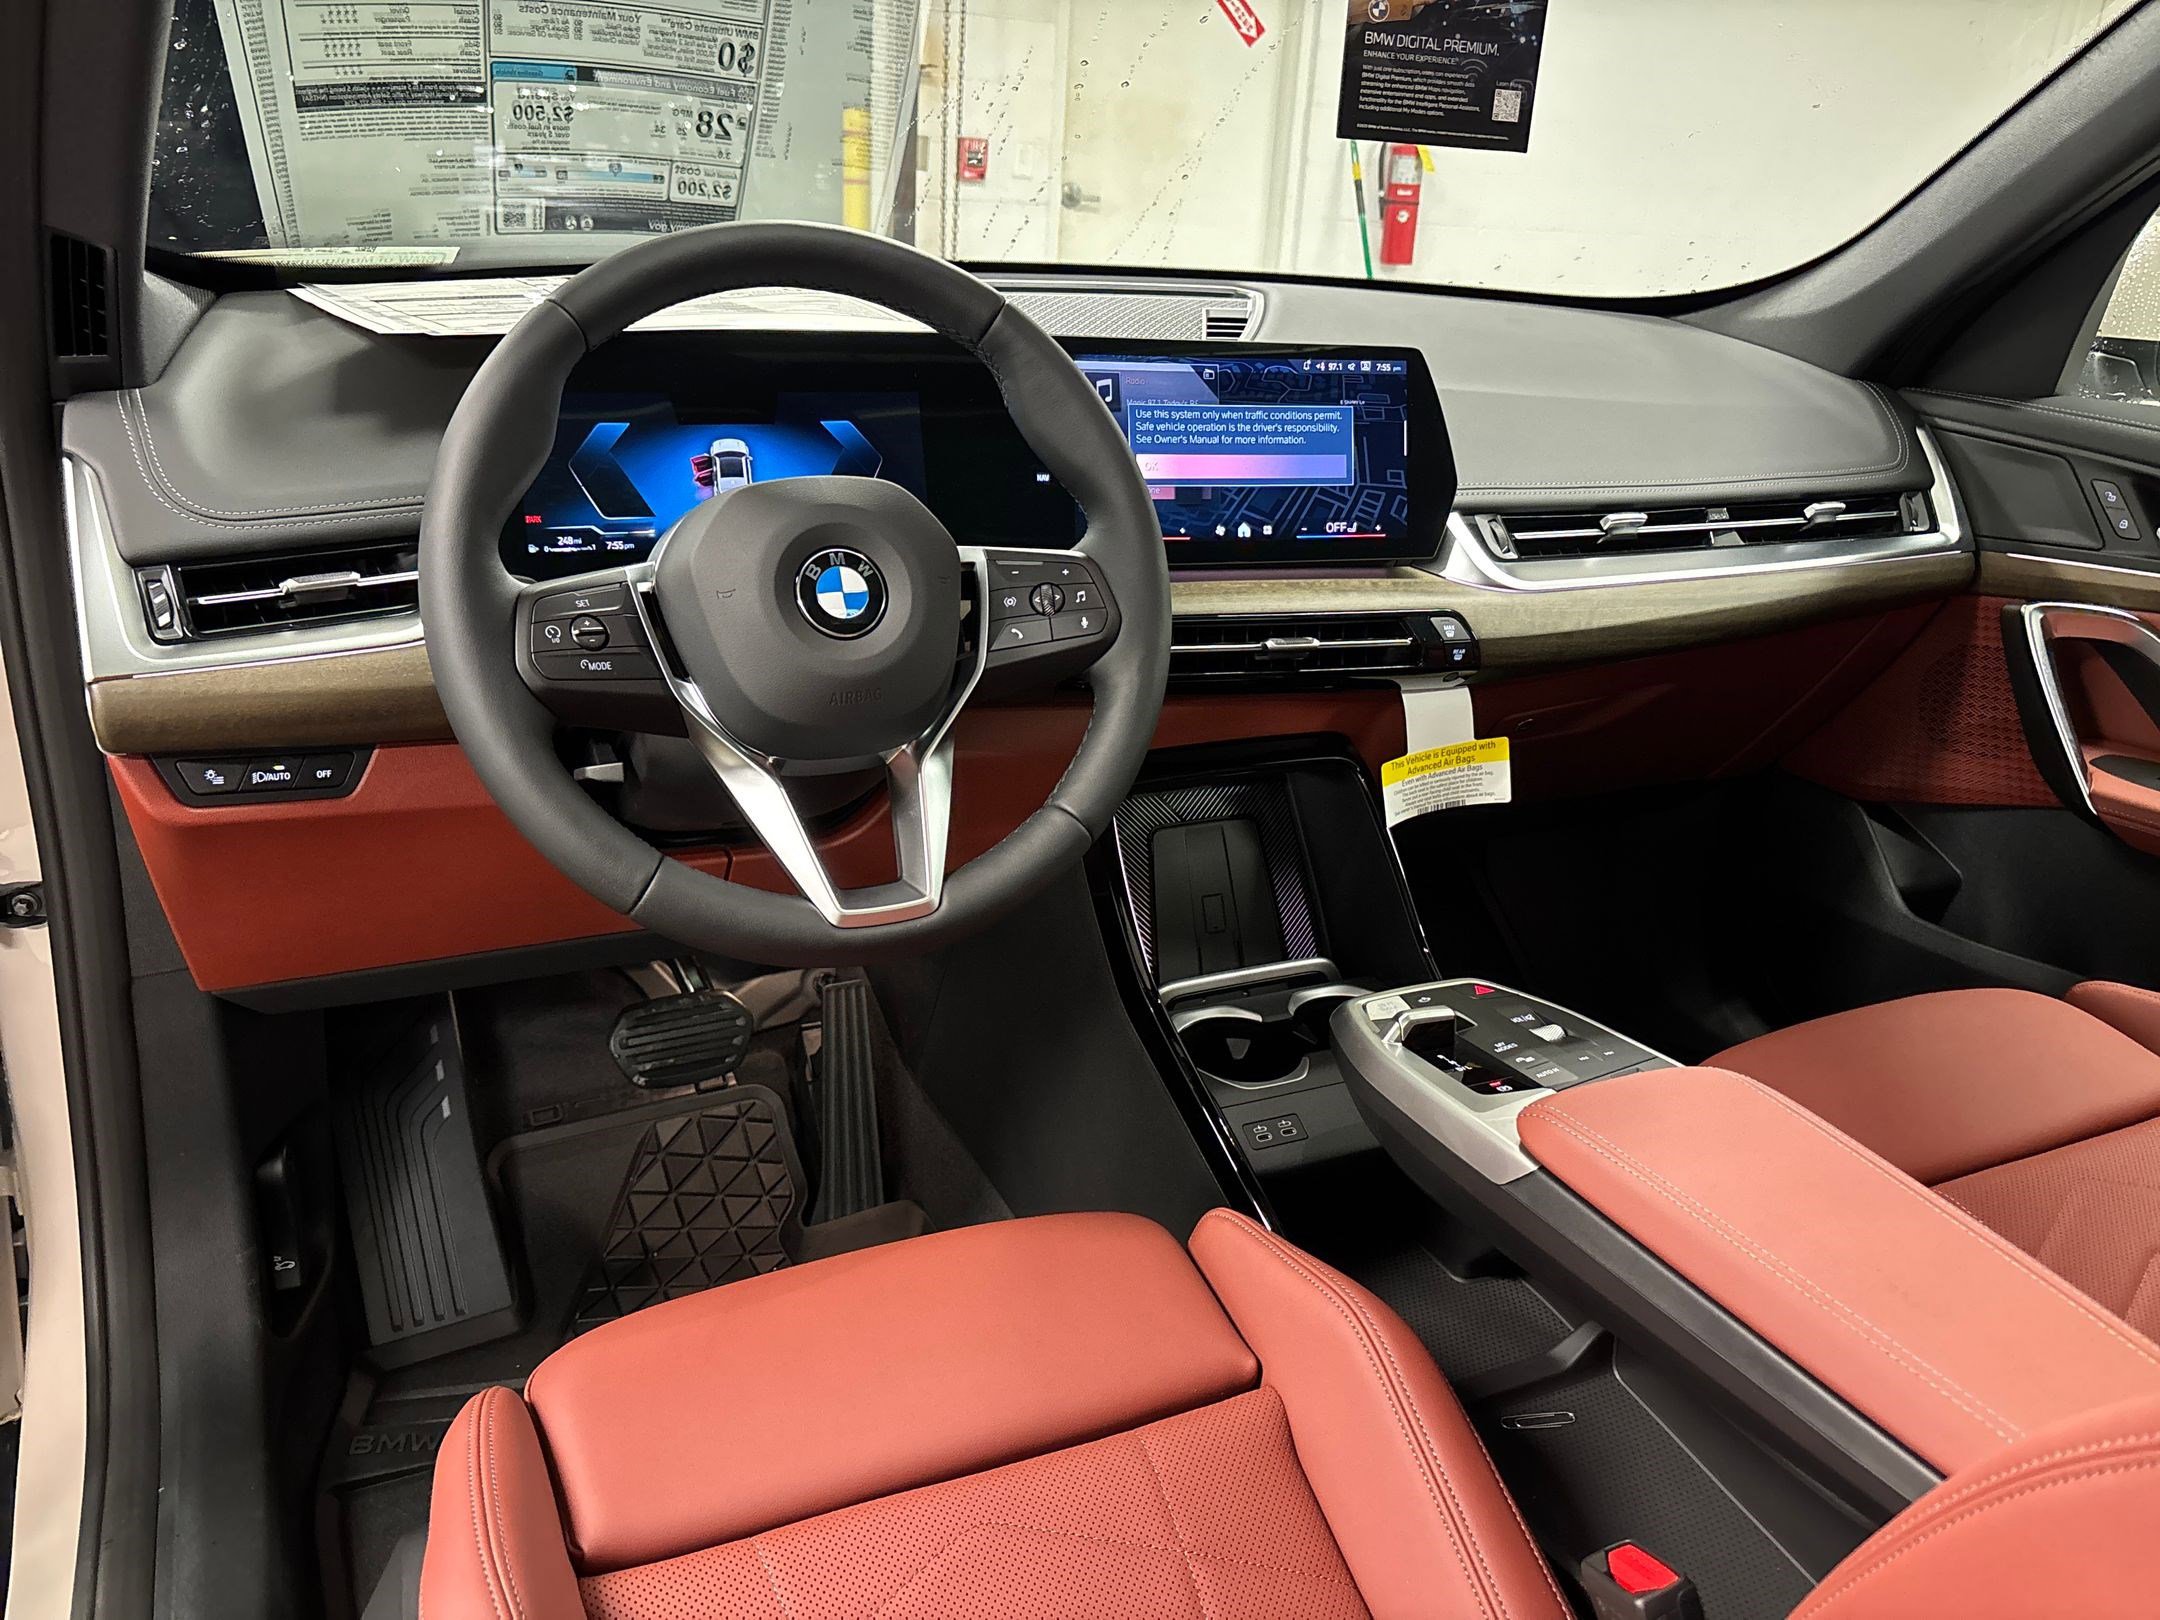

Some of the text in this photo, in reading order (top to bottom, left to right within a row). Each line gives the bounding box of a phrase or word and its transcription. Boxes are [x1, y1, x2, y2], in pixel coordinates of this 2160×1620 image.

[1364, 31, 1500, 57] BMW DIGITAL PREMIUM.
[1363, 50, 1395, 59] ENHANCE
[1328, 363, 1342, 371] 97.1
[1376, 363, 1391, 371] 7:55
[1135, 410, 1342, 421] Use this system only when traffic conditions permit.
[1135, 422, 1339, 433] Safe vehicle operation is the driver's responsibility.
[1136, 434, 1152, 443] See
[1154, 434, 1187, 443] Owner's
[1190, 435, 1219, 443] Manual
[1222, 435, 1232, 443] for
[1258, 435, 1306, 444] information.
[1145, 462, 1158, 471] OK
[1326, 522, 1347, 533] OFF
[804, 552, 874, 581] BMW
[575, 599, 590, 607] SET
[588, 661, 612, 671] MODE
[829, 687, 882, 706] AIRBAG
[1391, 762, 1405, 770] This
[1405, 752, 1432, 765] Vehicle
[1440, 743, 1478, 758] Equipped
[1478, 740, 1496, 750] with
[1407, 755, 1476, 776] Advanced Air Bags
[316, 770, 332, 779] OFF
[1402, 778, 1415, 787] Even
[1416, 774, 1428, 782] with
[1428, 768, 1457, 779] Advanced
[1467, 764, 1483, 772] Bags
[348, 1432, 439, 1455] BMW
